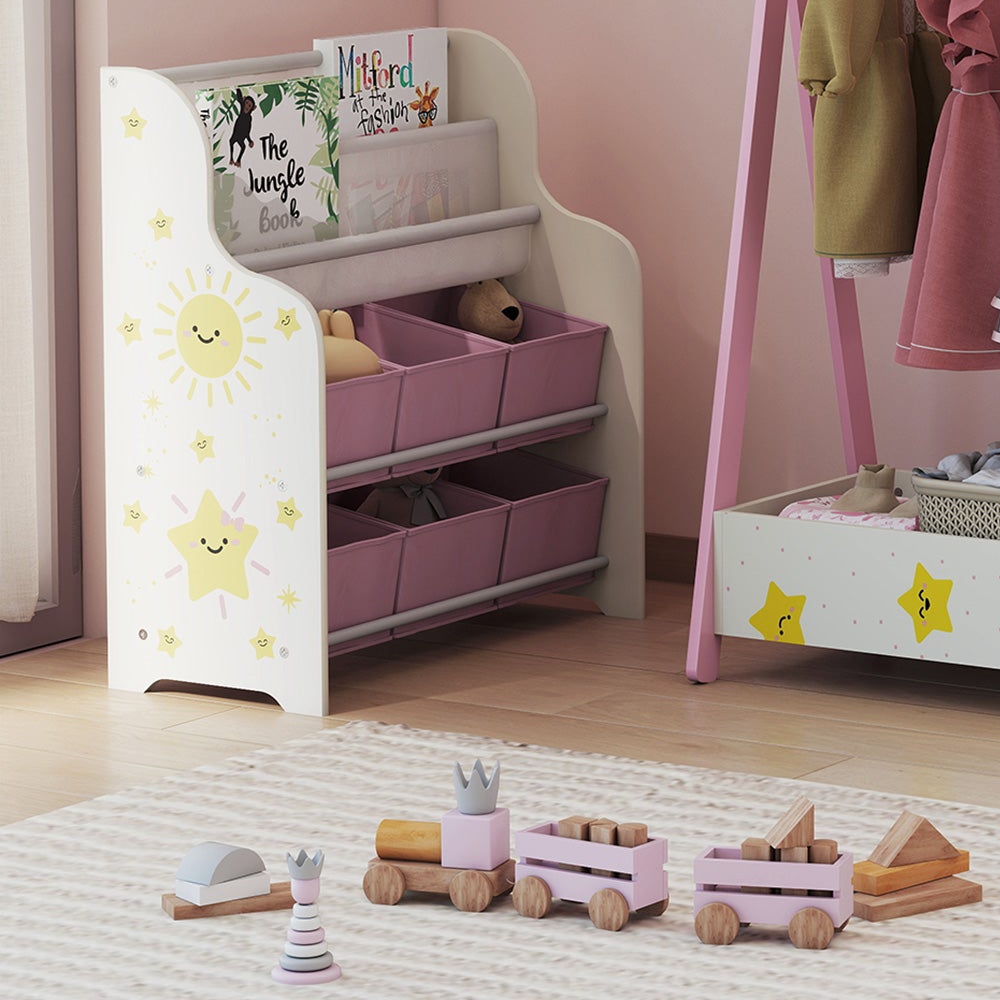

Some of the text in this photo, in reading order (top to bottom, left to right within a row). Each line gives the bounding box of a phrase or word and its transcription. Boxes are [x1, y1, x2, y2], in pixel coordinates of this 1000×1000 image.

[338, 34, 414, 100] Mitford
[352, 88, 387, 113] at the
[357, 97, 409, 136] fashion
[259, 132, 289, 161] The
[243, 158, 305, 203] Jungle
